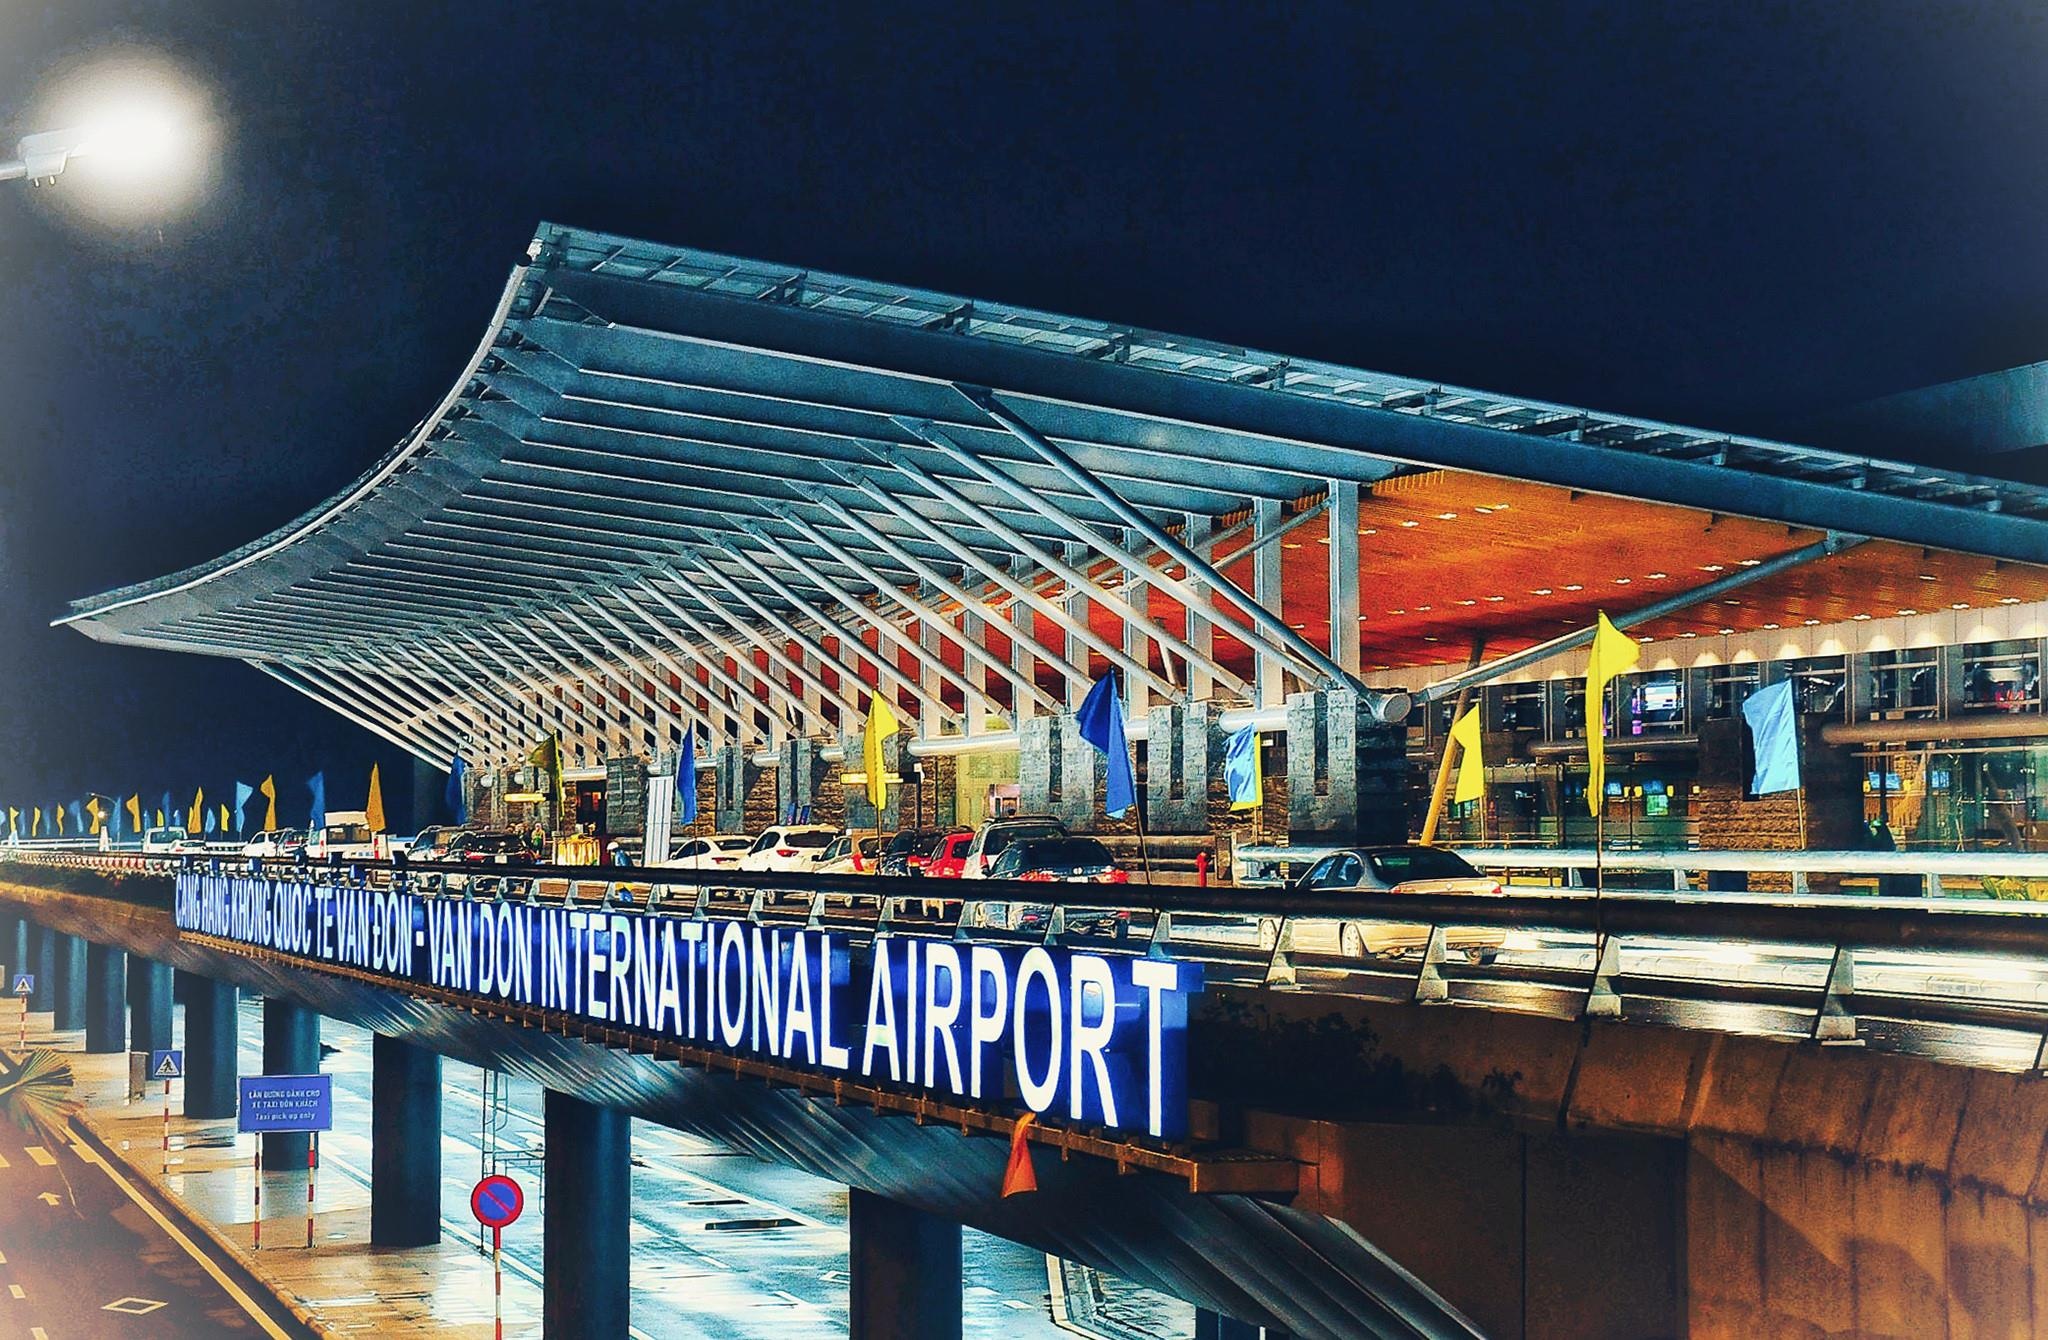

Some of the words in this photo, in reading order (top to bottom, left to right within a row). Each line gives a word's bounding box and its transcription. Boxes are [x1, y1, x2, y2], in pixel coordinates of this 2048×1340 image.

[428, 900, 472, 991] VAN
[479, 902, 533, 1003] DON
[541, 908, 849, 1070] INTERNATIONAL
[861, 938, 1178, 1137] AIRPORT
